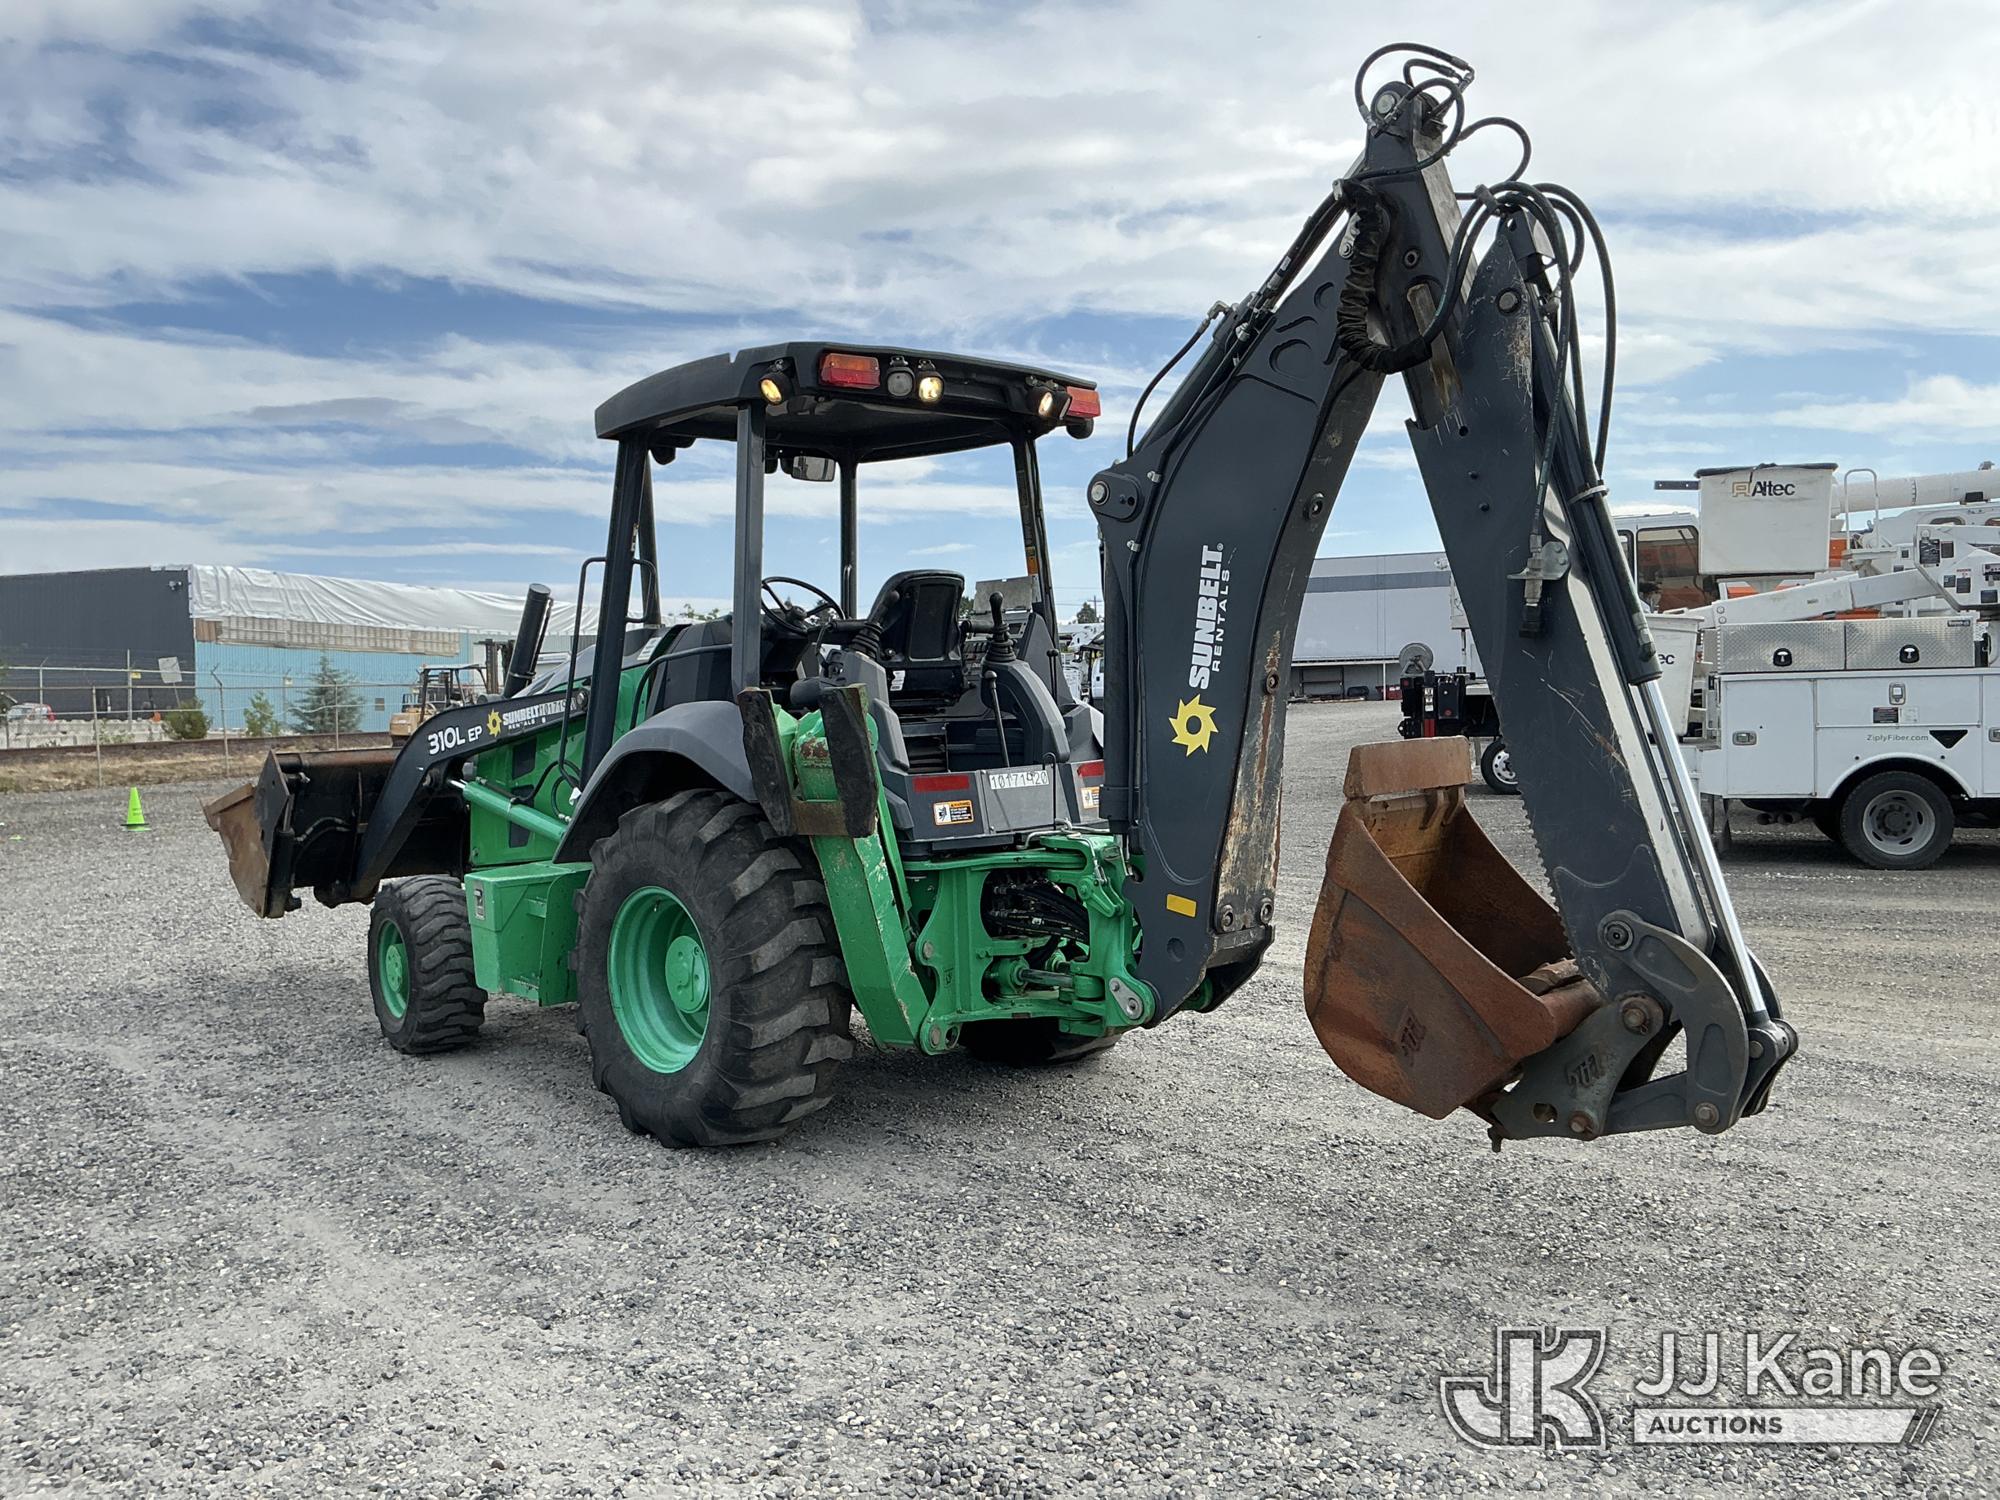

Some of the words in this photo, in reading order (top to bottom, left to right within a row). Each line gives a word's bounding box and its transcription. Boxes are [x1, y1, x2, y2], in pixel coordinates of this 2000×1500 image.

[1751, 480, 1796, 497] Altec
[1188, 544, 1223, 690] SUNBELT
[1211, 569, 1230, 672] RENTALS
[502, 704, 540, 726] SUNBELT
[427, 725, 466, 755] 310L
[467, 725, 483, 742] EP
[1866, 733, 1930, 742] ZiplyFiber.com
[990, 771, 1049, 789] 10171920
